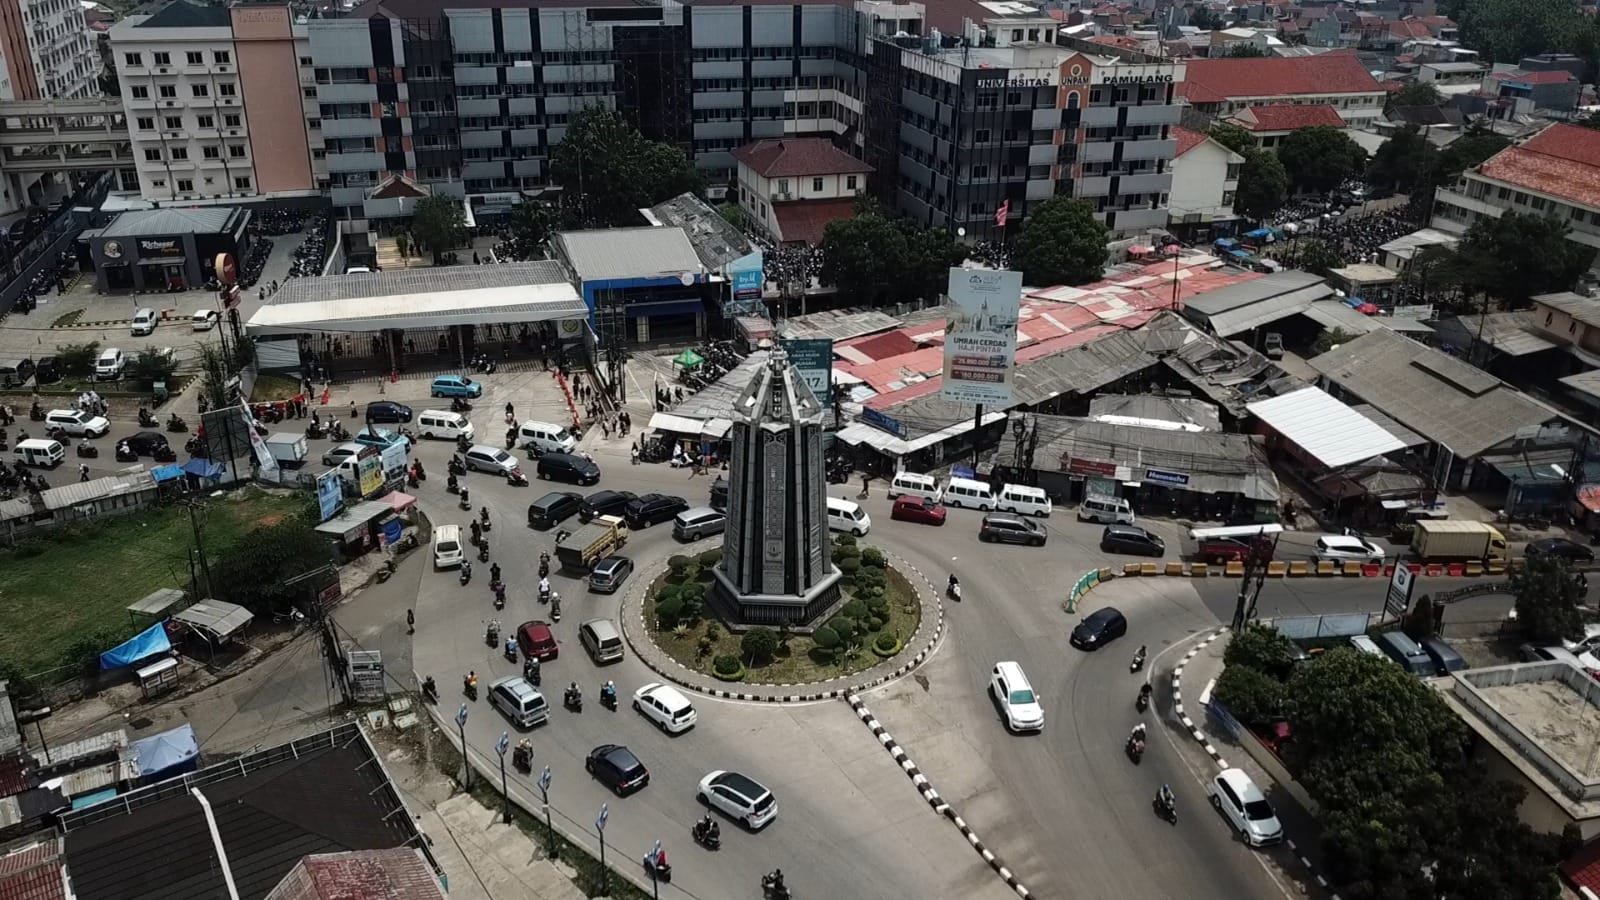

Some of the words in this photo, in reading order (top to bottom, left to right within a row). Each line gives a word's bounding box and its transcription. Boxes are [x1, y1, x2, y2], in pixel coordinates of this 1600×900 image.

[976, 77, 1050, 88] UNIVERSITAS
[1102, 74, 1174, 84] PAMULANG
[1061, 76, 1090, 86] UNPAM
[953, 337, 978, 346] UMRAH
[979, 339, 1007, 348] CERDAS
[958, 344, 975, 352] HAJI
